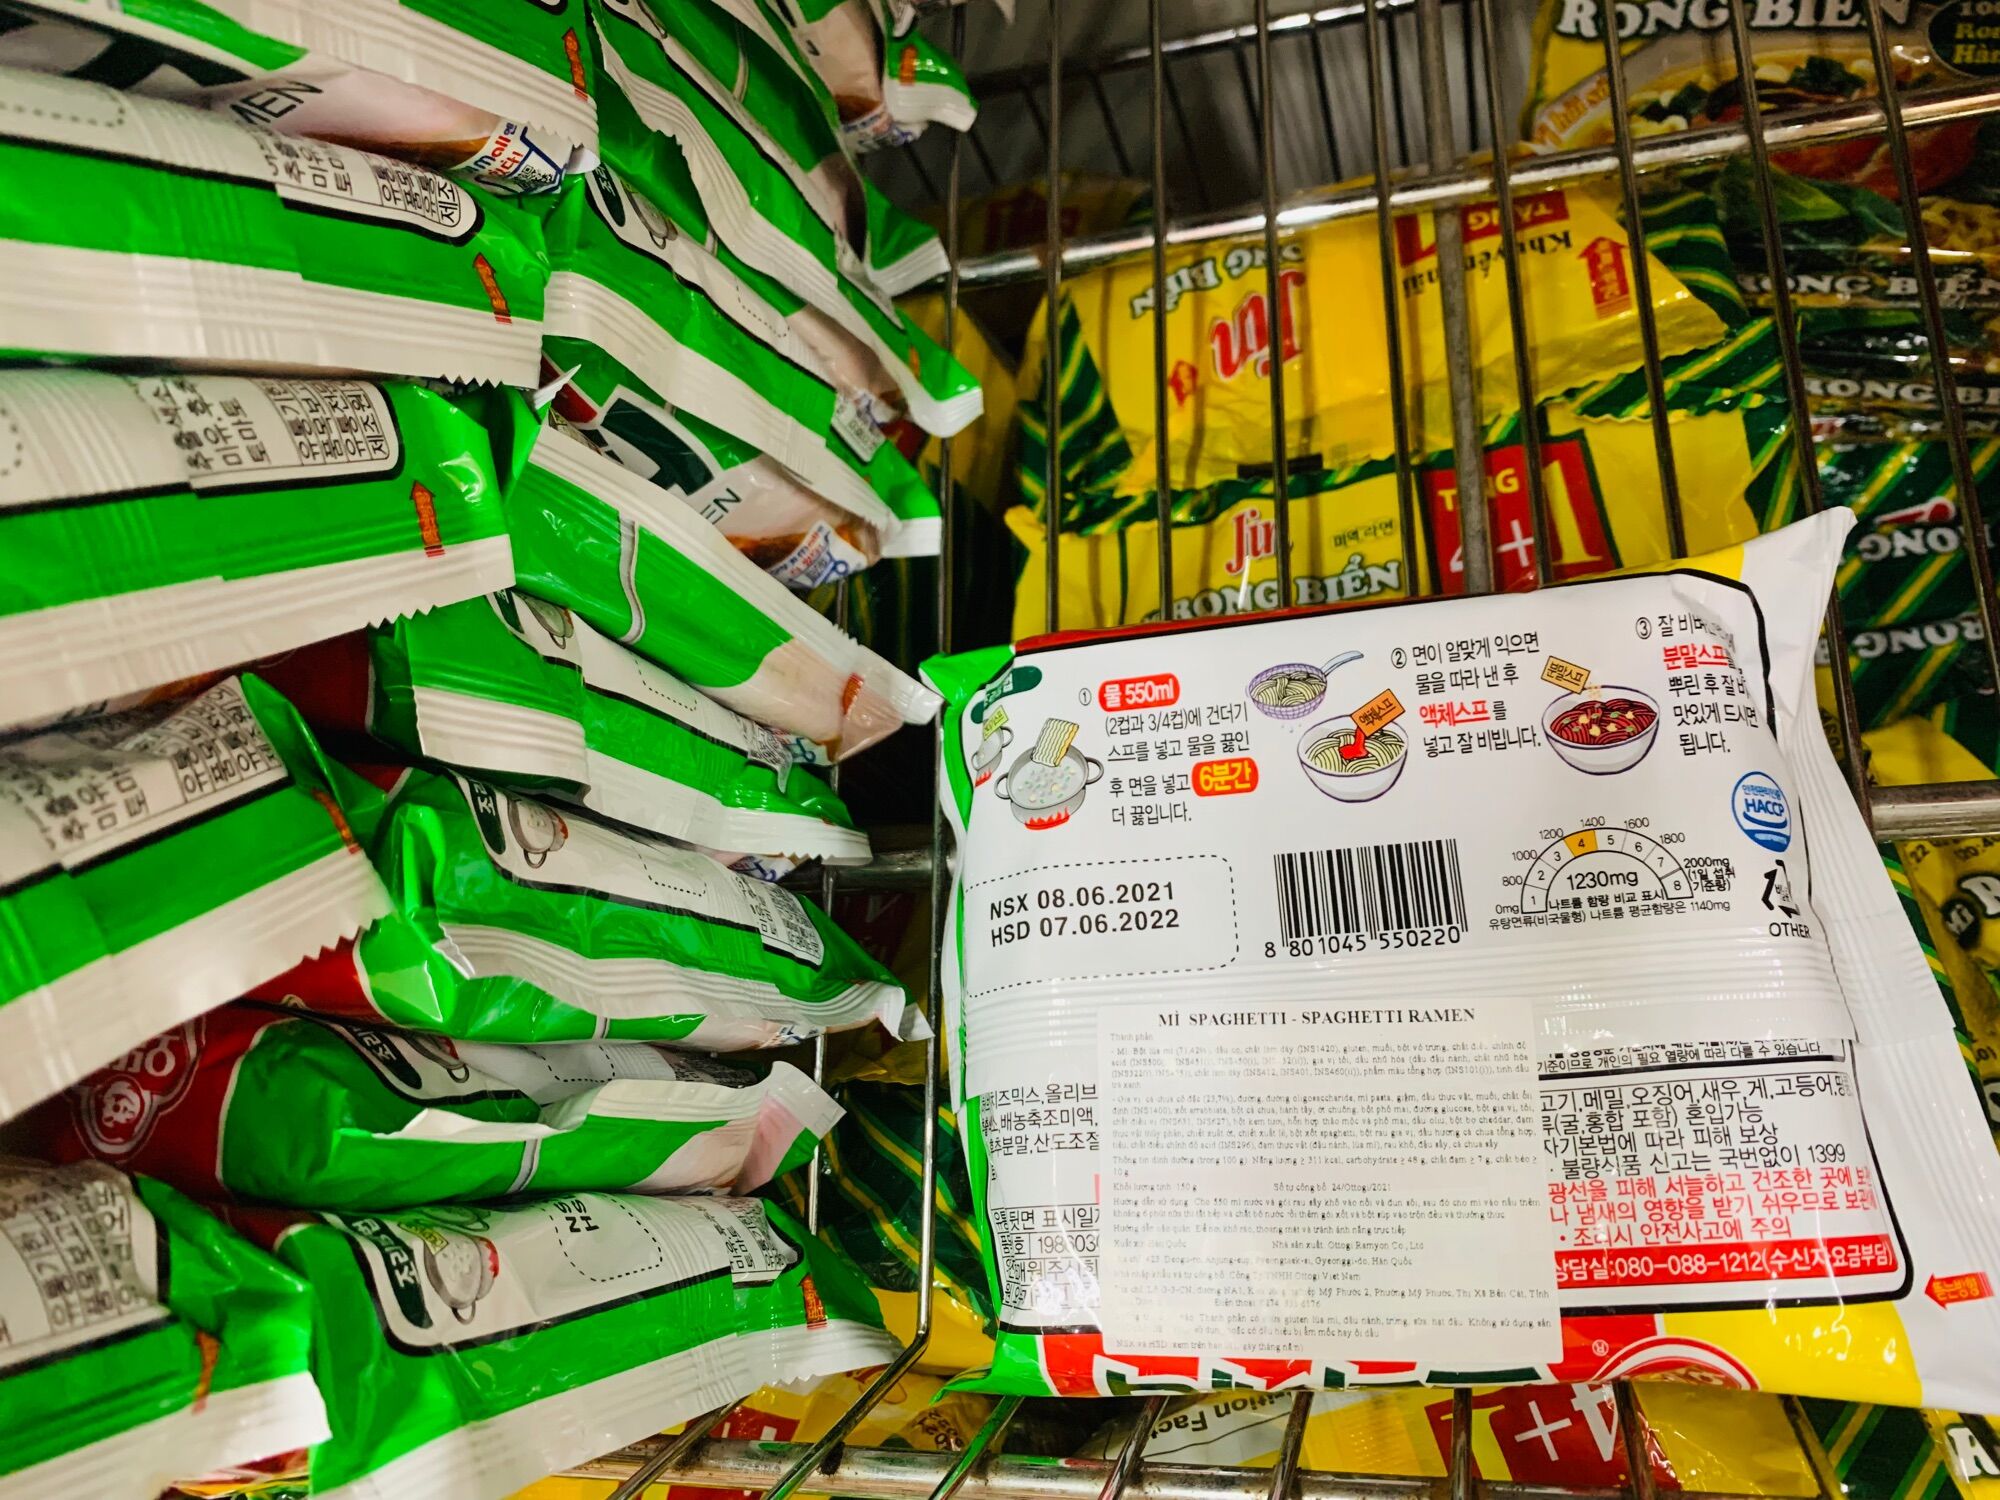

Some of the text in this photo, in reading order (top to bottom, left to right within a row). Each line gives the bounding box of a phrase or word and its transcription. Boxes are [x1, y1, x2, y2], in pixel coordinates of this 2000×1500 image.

[1295, 552, 1402, 605] BIỂN
[1657, 613, 1675, 638] 잘
[1412, 631, 1541, 667] 면이 알맞게 익으면
[1415, 662, 1520, 696] 물을 따라 낸 후
[1546, 661, 1585, 687] 분말스프
[1668, 673, 1737, 698] 뿌린 후 잘
[1103, 678, 1175, 709] 물 550ml
[1105, 701, 1249, 737] (2컵과 3/4컵)에 건더기
[1358, 697, 1397, 727] 액체스프
[1419, 700, 1508, 729] 액체스프 를
[1673, 702, 1760, 730] 맛있게 드시면
[1107, 730, 1250, 762] 스프를 넣고 물을 끓인
[1423, 724, 1542, 759] 넣고 잘 비빕니다.
[1679, 730, 1731, 757] 됩니다.
[1109, 759, 1252, 798] 후 면을 넣고 6분간
[1111, 800, 1193, 827] 더 끓입니다.
[1744, 797, 1785, 818] HACCP
[1538, 827, 1564, 840] 1200
[1580, 815, 1606, 828] 1400
[1624, 817, 1650, 830] 1600
[1577, 838, 1586, 849] 4
[1607, 834, 1615, 846] 5
[1634, 841, 1643, 853] 6
[1659, 832, 1686, 845] 1800
[1511, 849, 1538, 861] 1000
[1553, 851, 1562, 862] 3
[1657, 857, 1664, 868] 7
[1683, 857, 1730, 871] 2000mg
[1502, 875, 1523, 887] 800
[1537, 870, 1545, 881] 2
[1566, 870, 1639, 891] 1230mg
[1673, 880, 1682, 891] 8
[989, 880, 1175, 921] NSX 08.06.2021
[1495, 904, 1520, 915] 0mg
[1530, 895, 1537, 905] 1
[1549, 888, 1665, 911] 나트륨 함량 비교 표시
[1590, 905, 1625, 921] 나트륨
[1628, 900, 1687, 918] 평균함량은
[1690, 900, 1731, 912] 1140mg
[991, 908, 1180, 948] HSD 07.06.2022
[1768, 922, 1812, 939] OTHER
[1289, 934, 1367, 958] 801045
[1379, 925, 1461, 951] 550220
[1188, 1010, 1287, 1027] SPAGHETTI
[1301, 1009, 1403, 1026] SPAGHETTI
[1408, 1008, 1476, 1023] RAMEN
[1537, 1057, 1594, 1073] 기준이므로
[1598, 1054, 1633, 1069] 개인의
[1637, 1051, 1662, 1066] 필요
[1664, 1047, 1701, 1064] 열량에
[1704, 1046, 1727, 1060] 따라
[1731, 1045, 1755, 1059] 다를
[1758, 1044, 1771, 1057] 수
[1774, 1041, 1823, 1057] 있습니다.
[1632, 1104, 1679, 1130] 포함)
[1686, 1100, 1763, 1127] 혼입가능
[1645, 1127, 1685, 1151] 따라
[1693, 1125, 1733, 1148] 피해
[1739, 1122, 1779, 1146] 보상
[1562, 1143, 1846, 1181] 불량식품 신고는 국번없이 1399
[1547, 1165, 1854, 1205] 광선을 피해 서늘하고 건조한 곳에
[1550, 1204, 1569, 1227] 나
[1576, 1200, 1637, 1226] 냄새의
[1644, 1196, 1706, 1223] 영향을
[1712, 1193, 1754, 1218] 받기
[1761, 1190, 1841, 1215] 쉬우므로
[1640, 1217, 1744, 1246] 안전사고에
[1750, 1215, 1793, 1240] 주의
